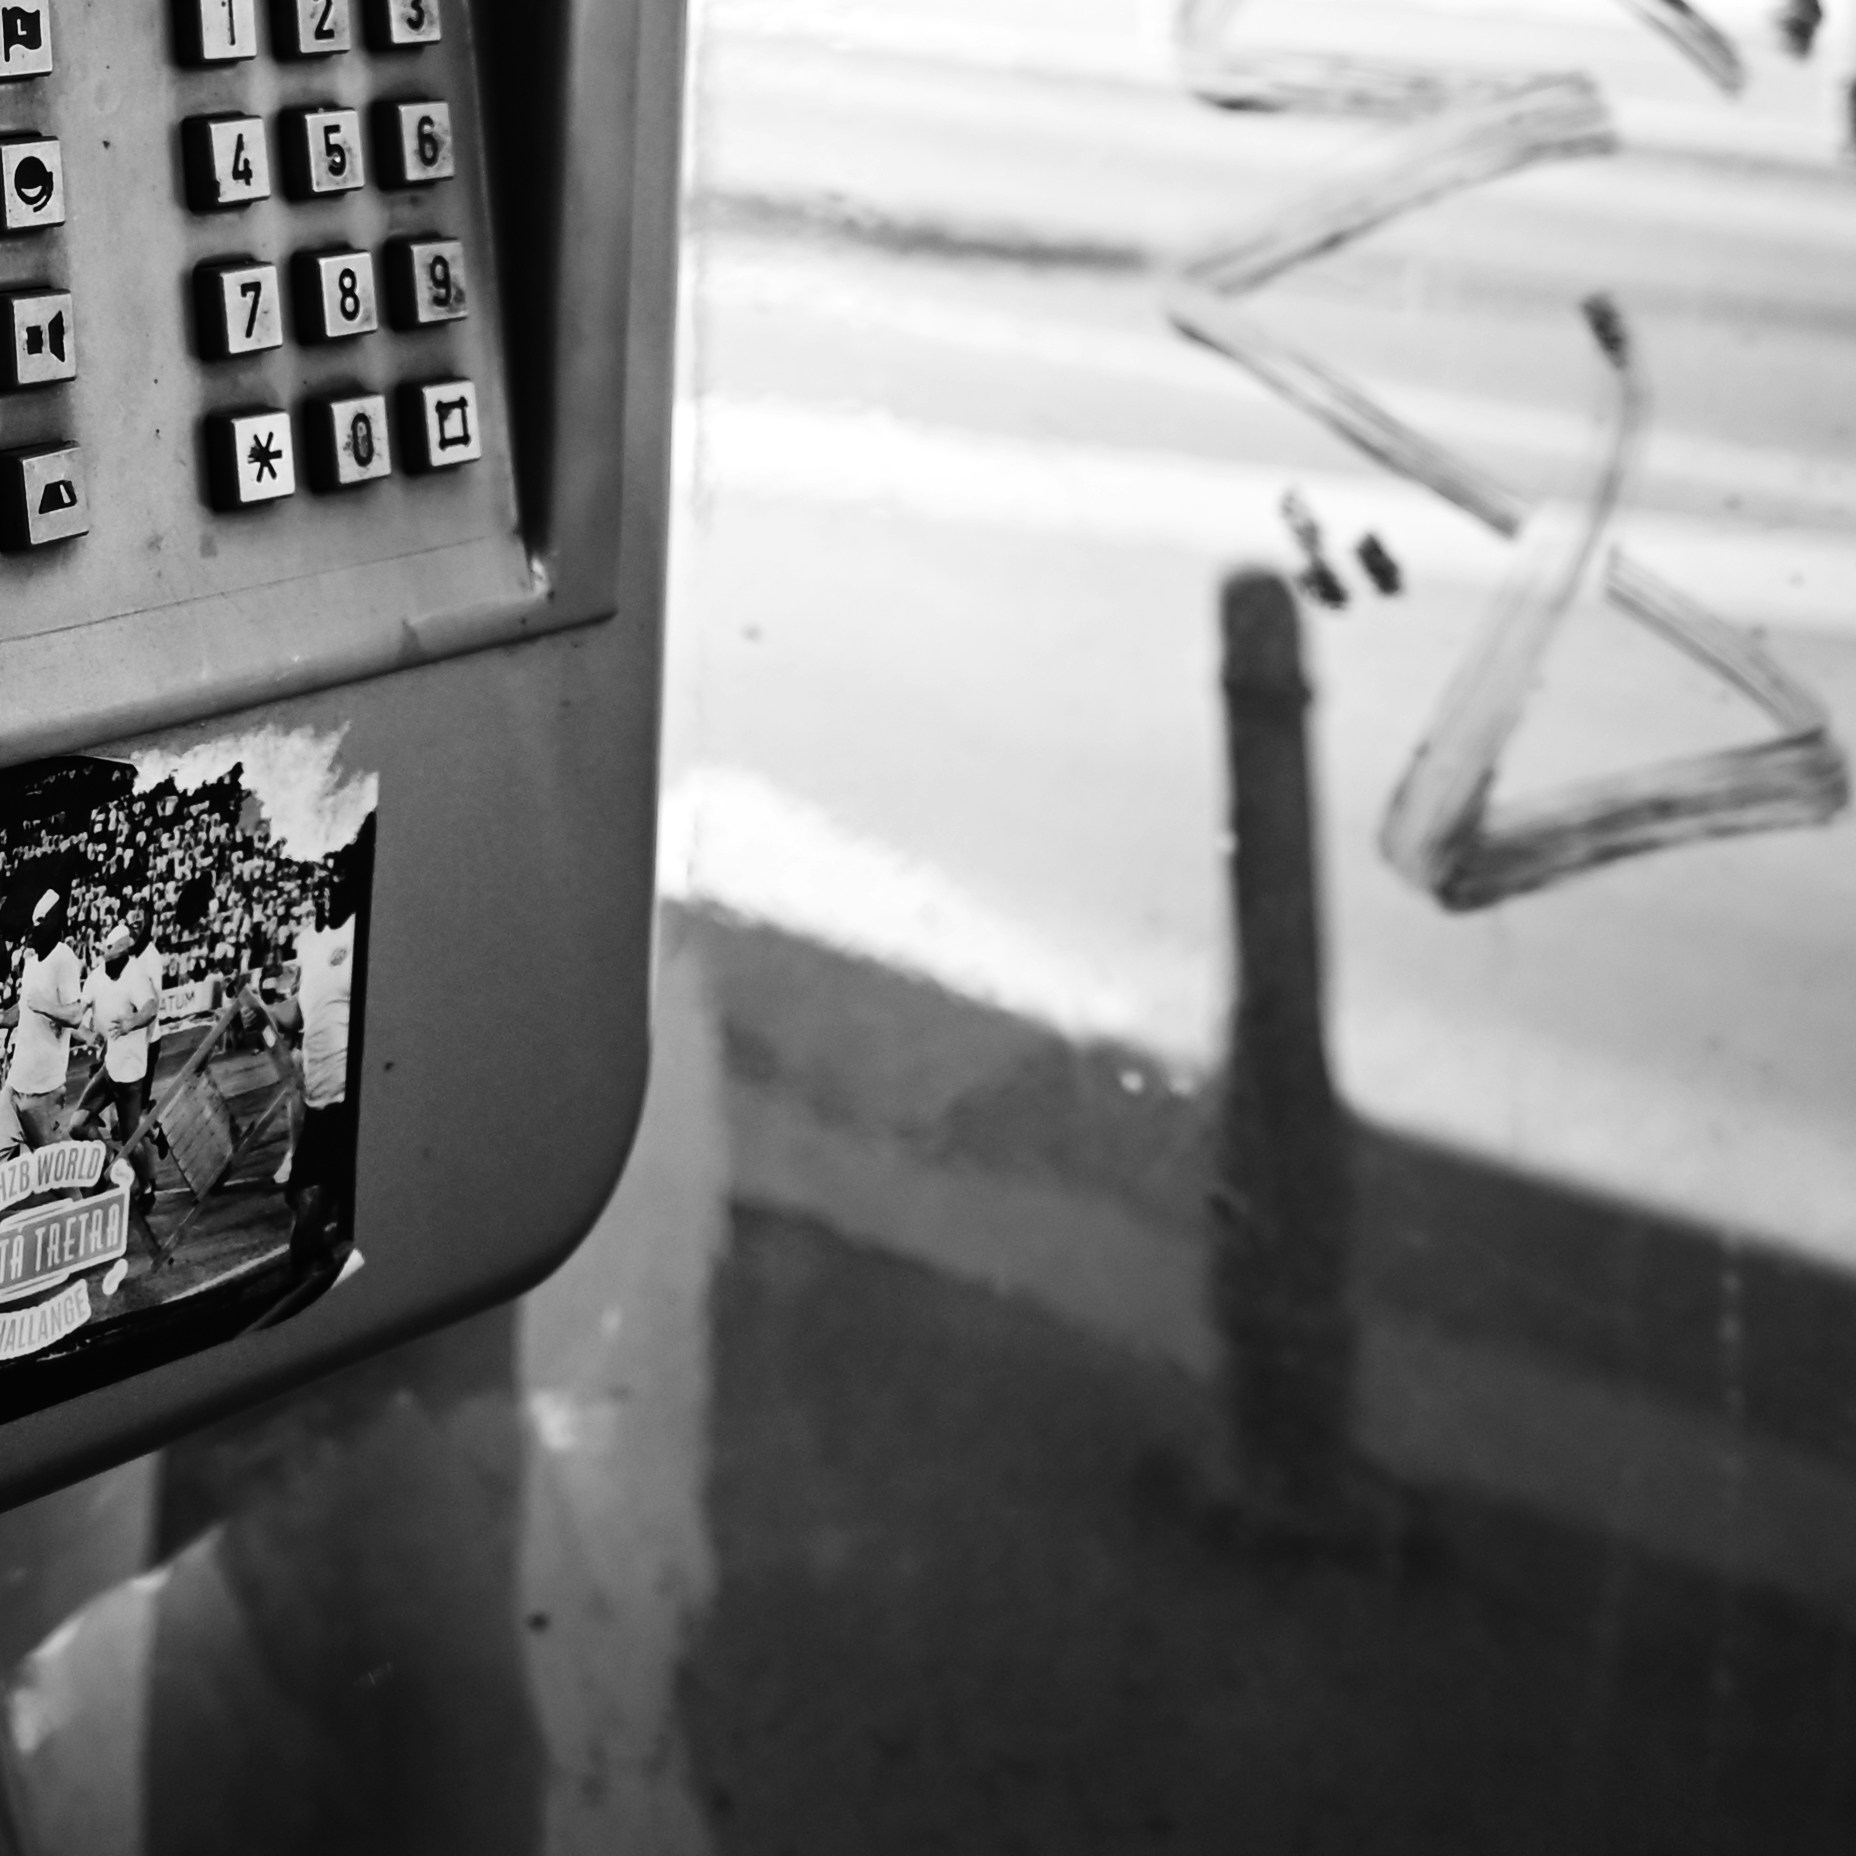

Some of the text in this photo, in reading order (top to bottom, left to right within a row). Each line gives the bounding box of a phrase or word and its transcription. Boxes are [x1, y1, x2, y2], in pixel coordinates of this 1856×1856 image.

[231, 114, 438, 187] 4 5 6
[239, 255, 452, 340] 7 8 9
[350, 411, 375, 469] 0
[37, 1146, 102, 1186] WORLD
[34, 1202, 121, 1273] TRETRA
